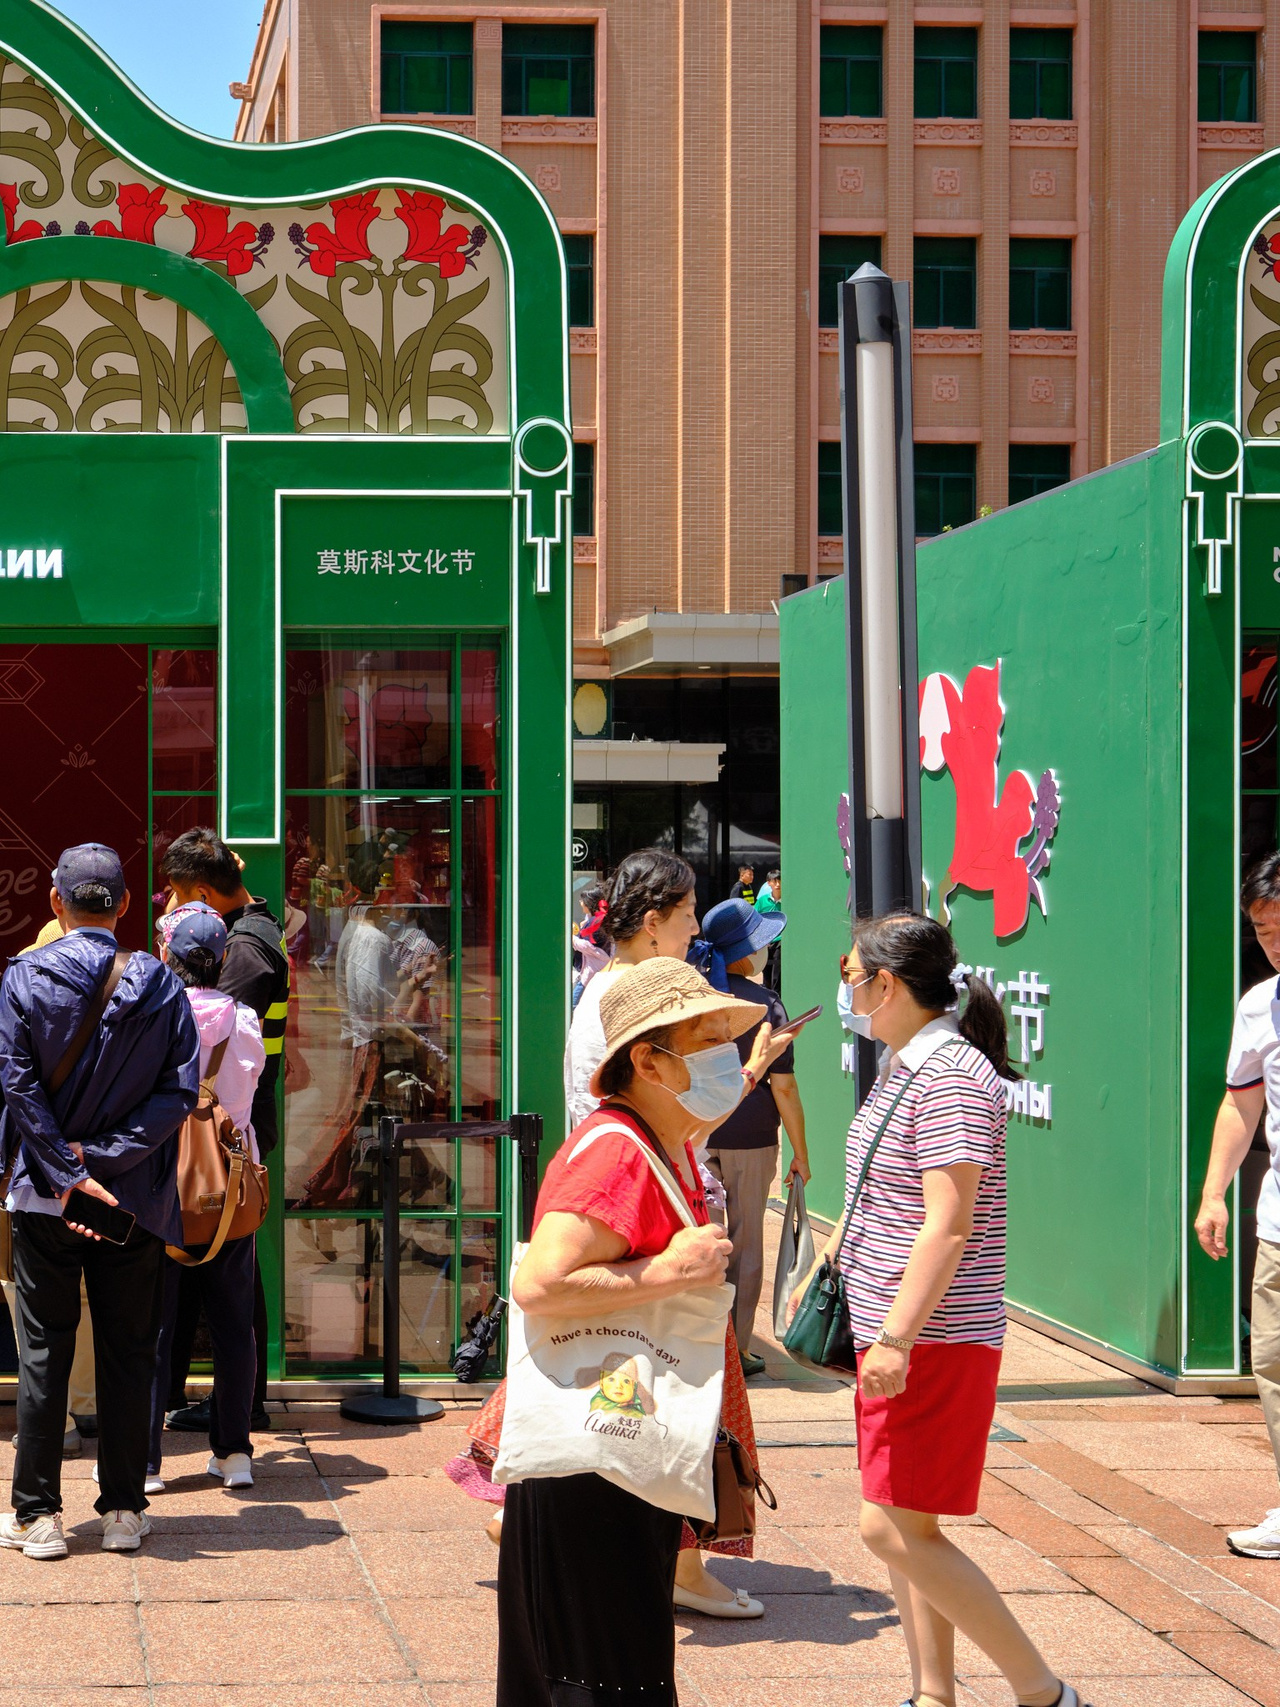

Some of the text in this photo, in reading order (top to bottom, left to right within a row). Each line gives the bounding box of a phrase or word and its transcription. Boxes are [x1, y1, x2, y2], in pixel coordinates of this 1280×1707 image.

[316, 549, 476, 575] 莫斯科文化节
[550, 1326, 681, 1367] Have a chocolate day!
